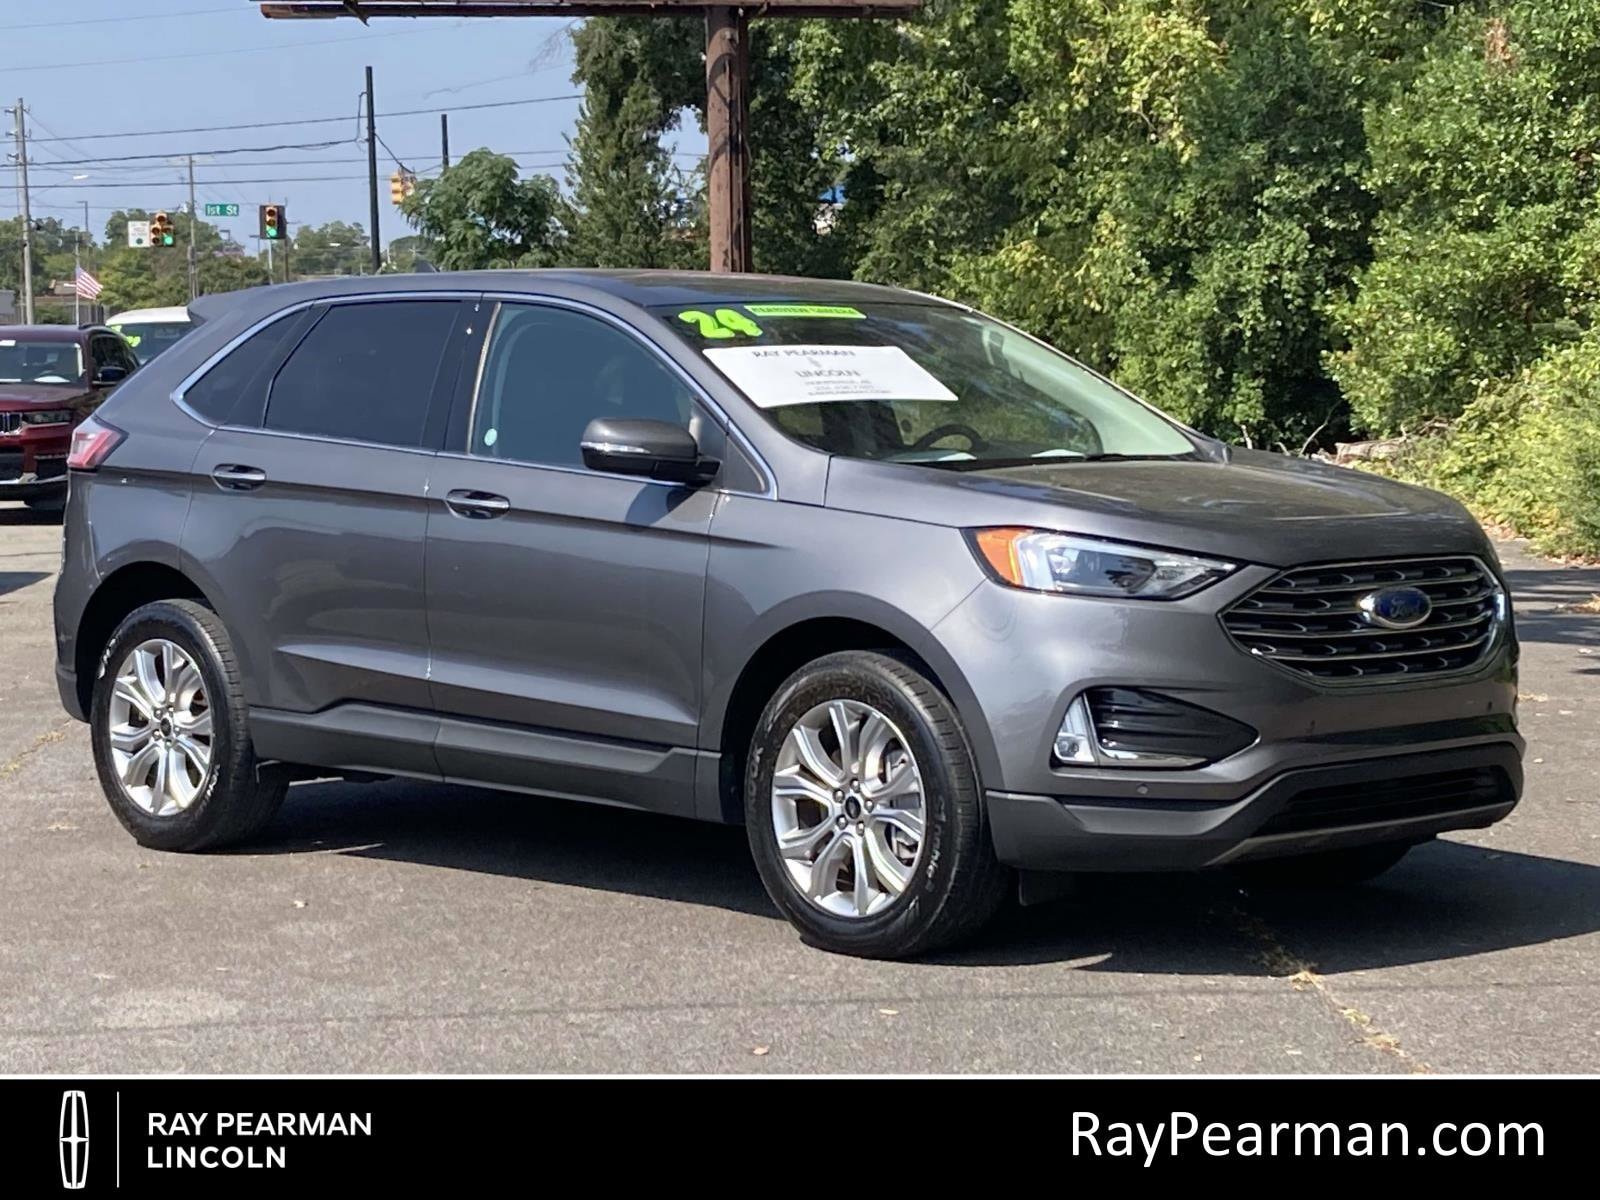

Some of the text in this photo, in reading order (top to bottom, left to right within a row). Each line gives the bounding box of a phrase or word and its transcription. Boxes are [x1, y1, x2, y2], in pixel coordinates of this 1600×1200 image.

[207, 205, 237, 215] 1st St
[678, 309, 763, 338] 24
[752, 349, 856, 358] RAY PEARMAN
[794, 369, 862, 378] LINCOLN
